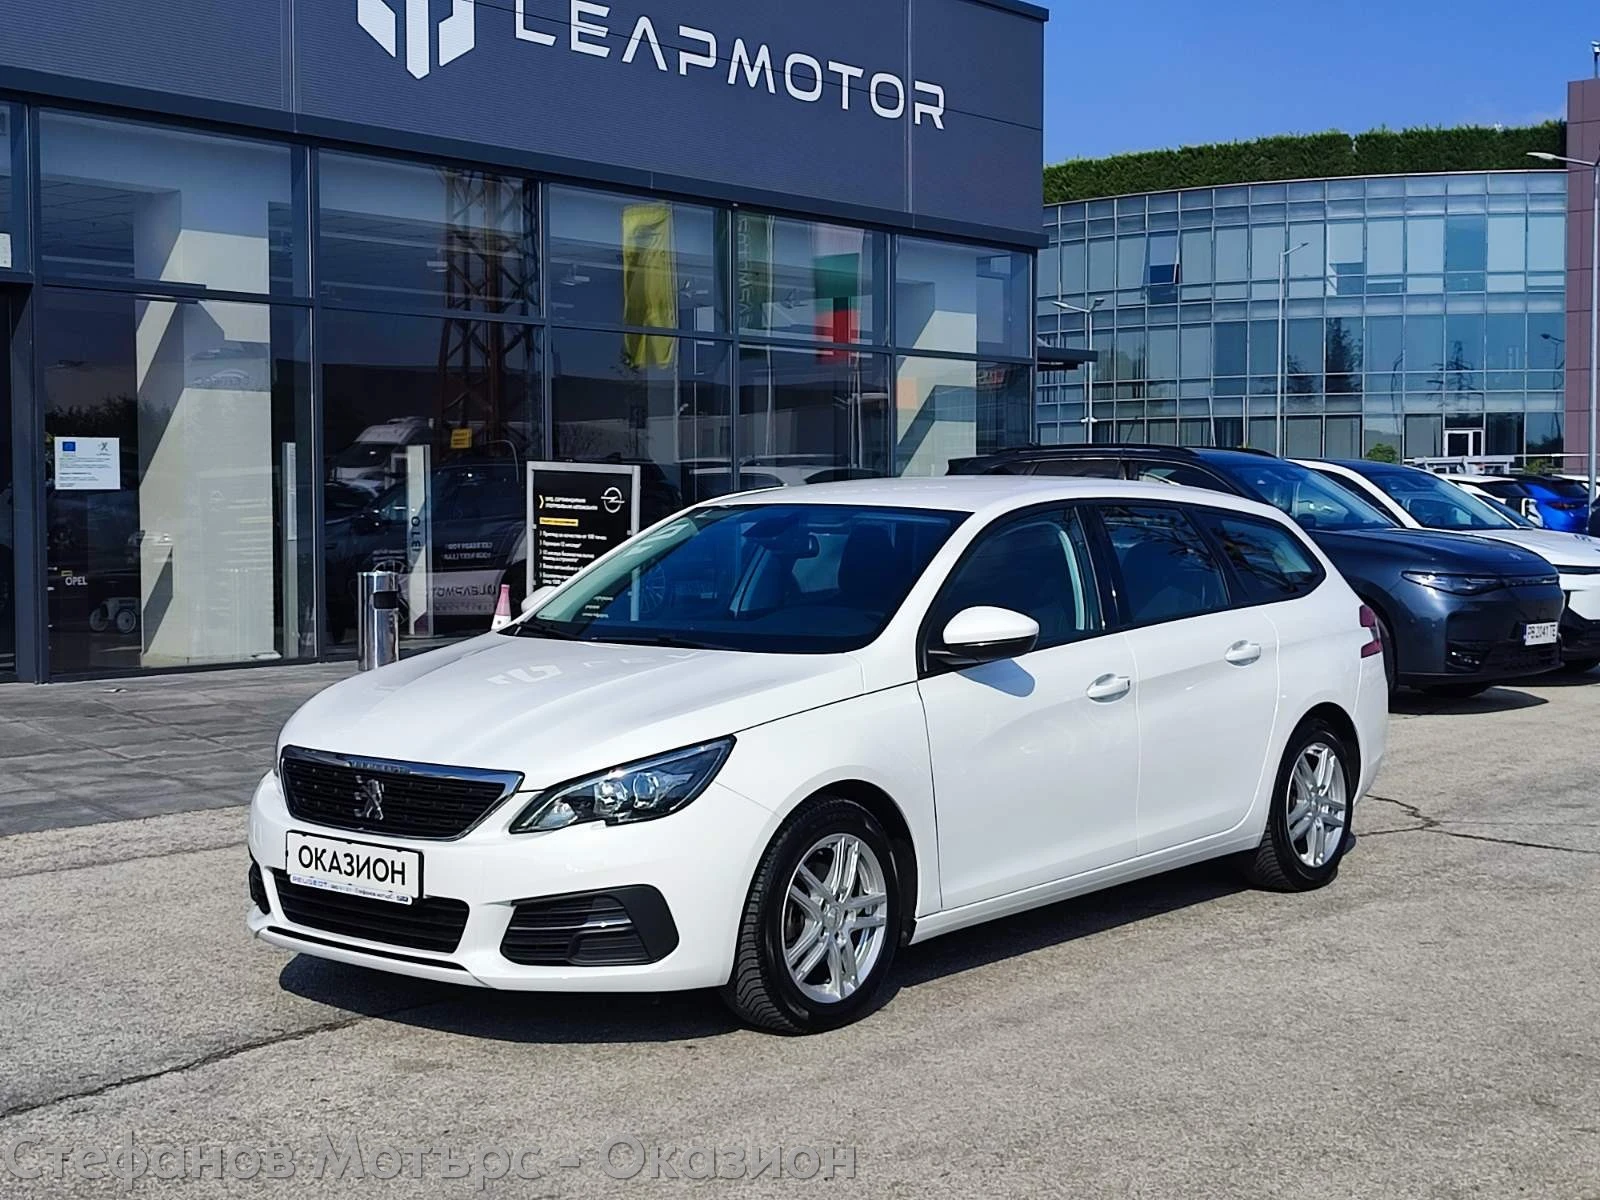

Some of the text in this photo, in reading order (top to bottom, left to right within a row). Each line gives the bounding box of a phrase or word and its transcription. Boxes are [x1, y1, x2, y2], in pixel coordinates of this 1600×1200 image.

[515, 0, 945, 130] LEAPMOTOR
[65, 576, 88, 586] OPEL
[298, 845, 406, 885] ОКАЗИОН
